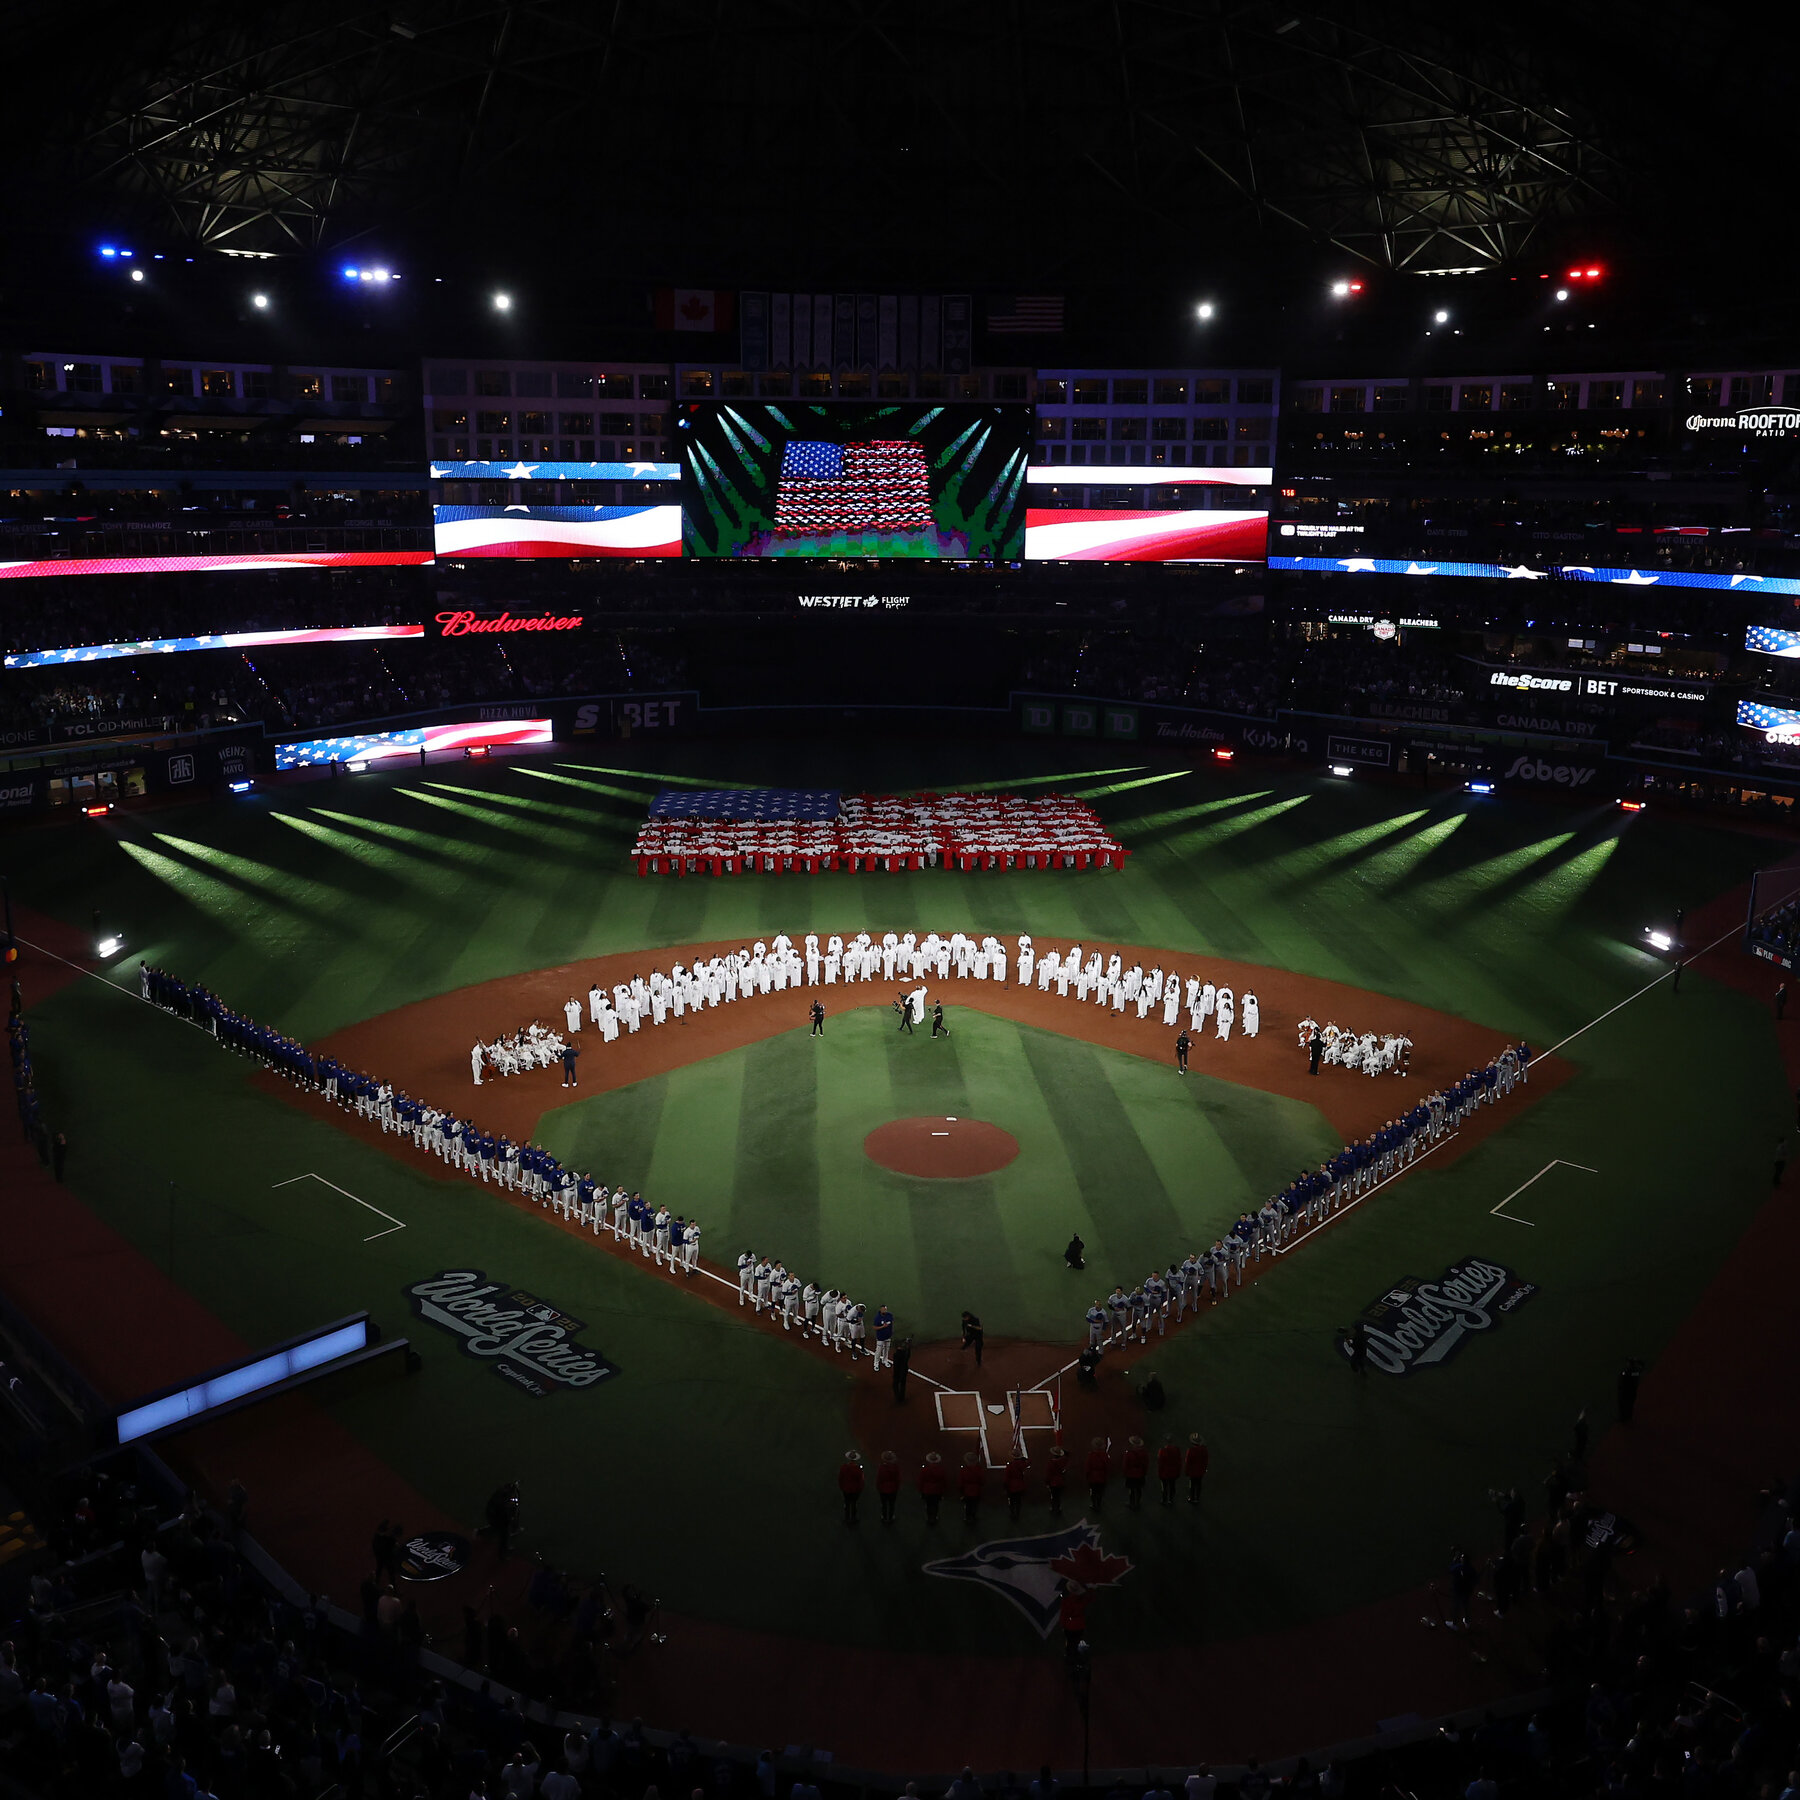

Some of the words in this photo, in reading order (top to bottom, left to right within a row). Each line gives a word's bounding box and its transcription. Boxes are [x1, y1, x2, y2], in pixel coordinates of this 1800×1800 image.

[1686, 414, 1737, 432] Corona
[1755, 429, 1786, 437] PATIO
[798, 595, 863, 608] WESTJET
[881, 596, 911, 604] FLIGHT
[435, 610, 583, 637] Budweiser
[1328, 614, 1358, 623] CANADA
[1359, 616, 1375, 624] DRY
[1399, 618, 1439, 627] BLEACHERS
[1489, 671, 1573, 692] theScore
[1586, 679, 1619, 697] BET
[1622, 686, 1669, 698] SPORTSBOOK
[1676, 692, 1706, 702] CASINO
[479, 706, 508, 719] PIZZA
[511, 704, 538, 718] NOVA
[64, 723, 95, 737] TCL
[1496, 714, 1562, 733] CANADA
[1565, 720, 1598, 736] DRY
[1334, 744, 1357, 755] THE
[1361, 747, 1384, 758] KEG
[223, 764, 244, 775] MAYO
[1504, 756, 1597, 788] Sobeys
[411, 1272, 546, 1338] World
[1344, 1295, 1454, 1374] World
[1418, 1259, 1507, 1330] Series
[467, 1324, 610, 1387] Series
